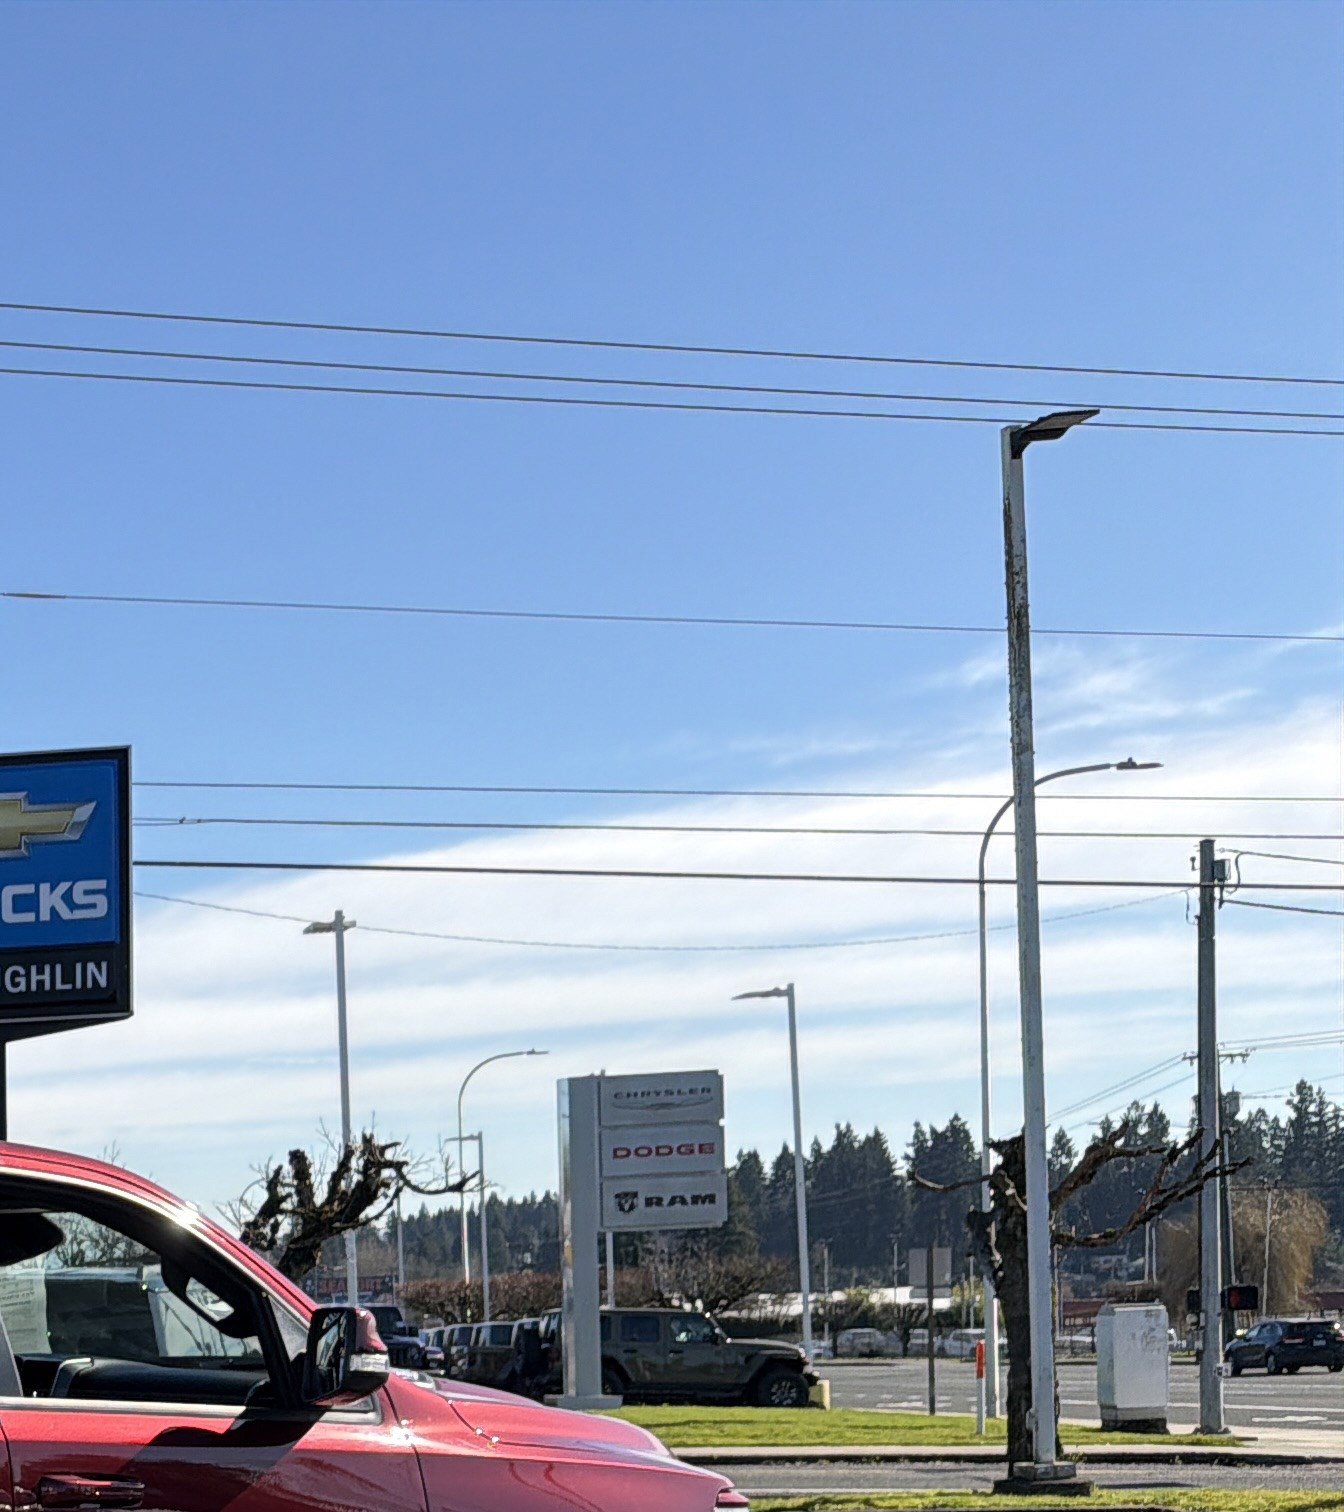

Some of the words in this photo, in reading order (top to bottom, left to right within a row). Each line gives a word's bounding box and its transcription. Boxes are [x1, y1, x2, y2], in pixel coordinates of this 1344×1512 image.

[613, 1087, 711, 1099] CHRYSLER
[613, 1143, 714, 1159] DODGE
[645, 1193, 716, 1208] RAM
